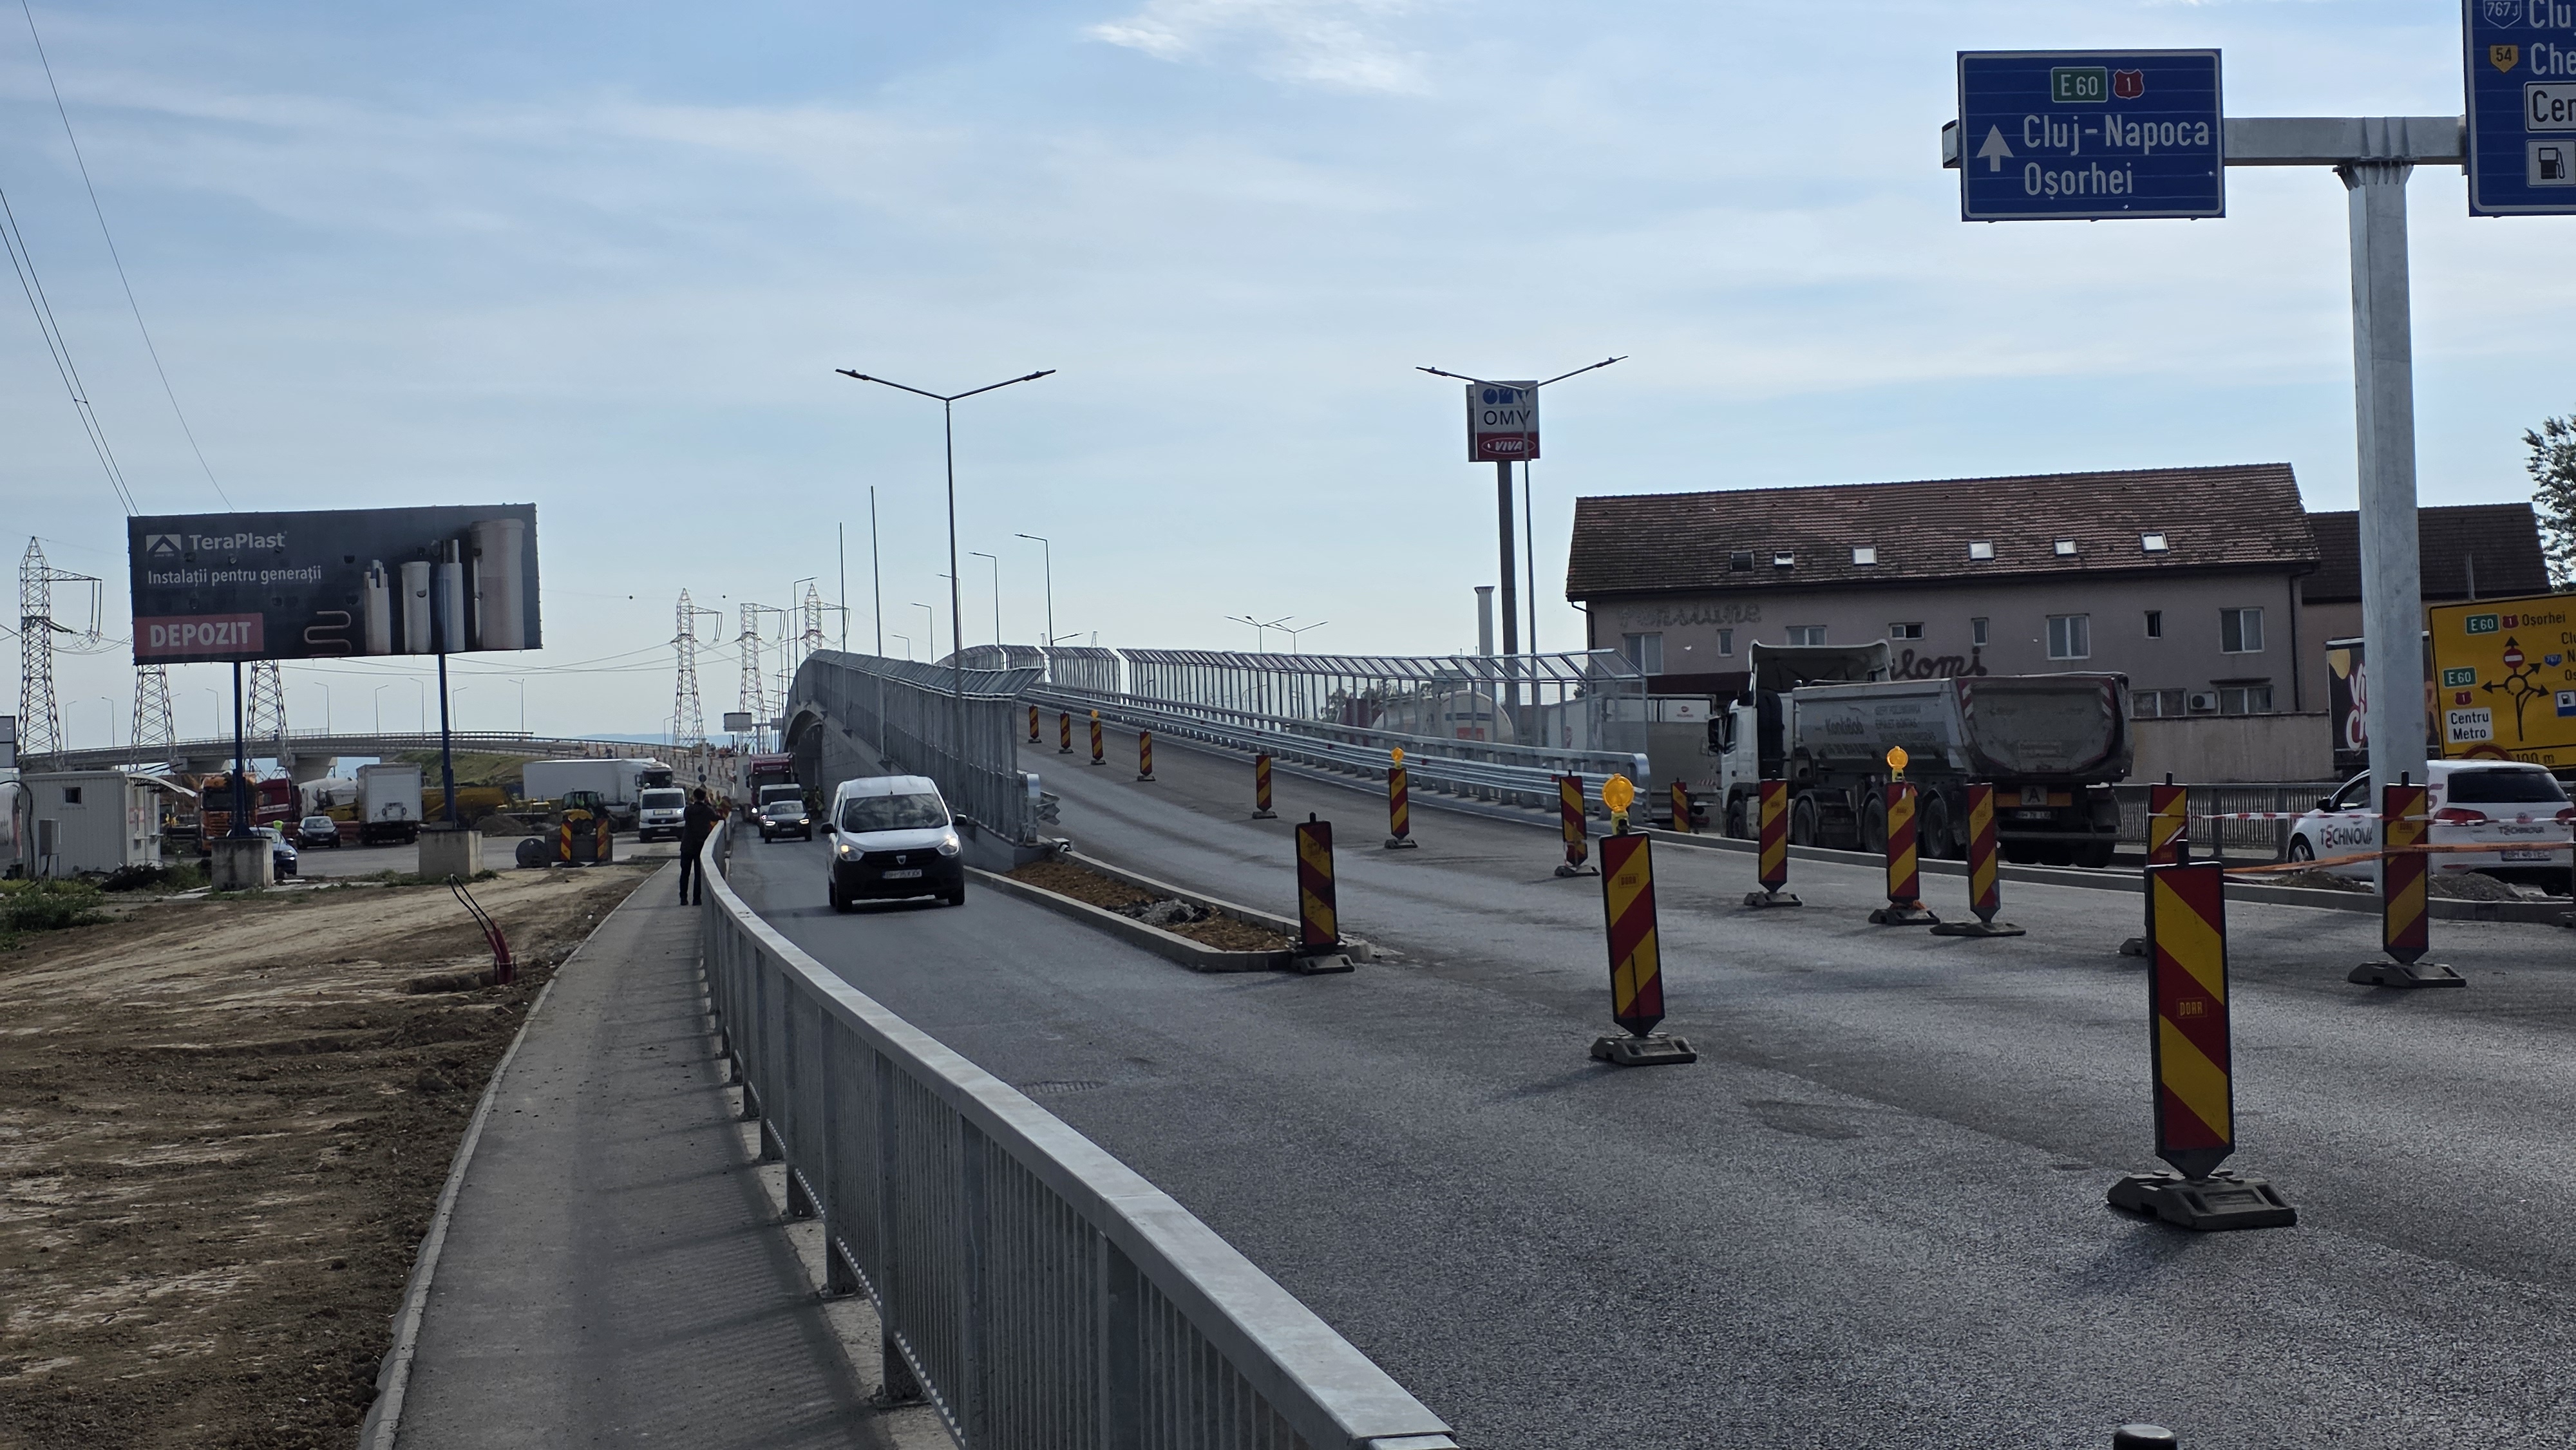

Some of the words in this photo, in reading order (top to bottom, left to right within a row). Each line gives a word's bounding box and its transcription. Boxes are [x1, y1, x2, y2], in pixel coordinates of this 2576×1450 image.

[2529, 0, 2576, 36] Clu
[2496, 48, 2512, 62] 54
[2061, 74, 2071, 96] E
[2076, 76, 2098, 97] 60
[2126, 77, 2132, 92] 1
[2023, 115, 2209, 156] Cluj-Napoca
[1483, 410, 1531, 425] OMV
[1495, 441, 1523, 451] VIVA
[189, 532, 285, 550] TeraPlast
[212, 569, 256, 587] pentru
[2470, 619, 2478, 631] E
[2481, 618, 2494, 630] 60
[150, 622, 251, 647] DEPOZIT
[2448, 672, 2456, 684] E
[2458, 672, 2471, 683] 60
[2461, 695, 2466, 703] 1
[2450, 711, 2489, 725] Centru
[2453, 728, 2486, 740] Metro
[2516, 752, 2539, 763] 100
[2544, 754, 2555, 764] m
[2028, 787, 2041, 802] A
